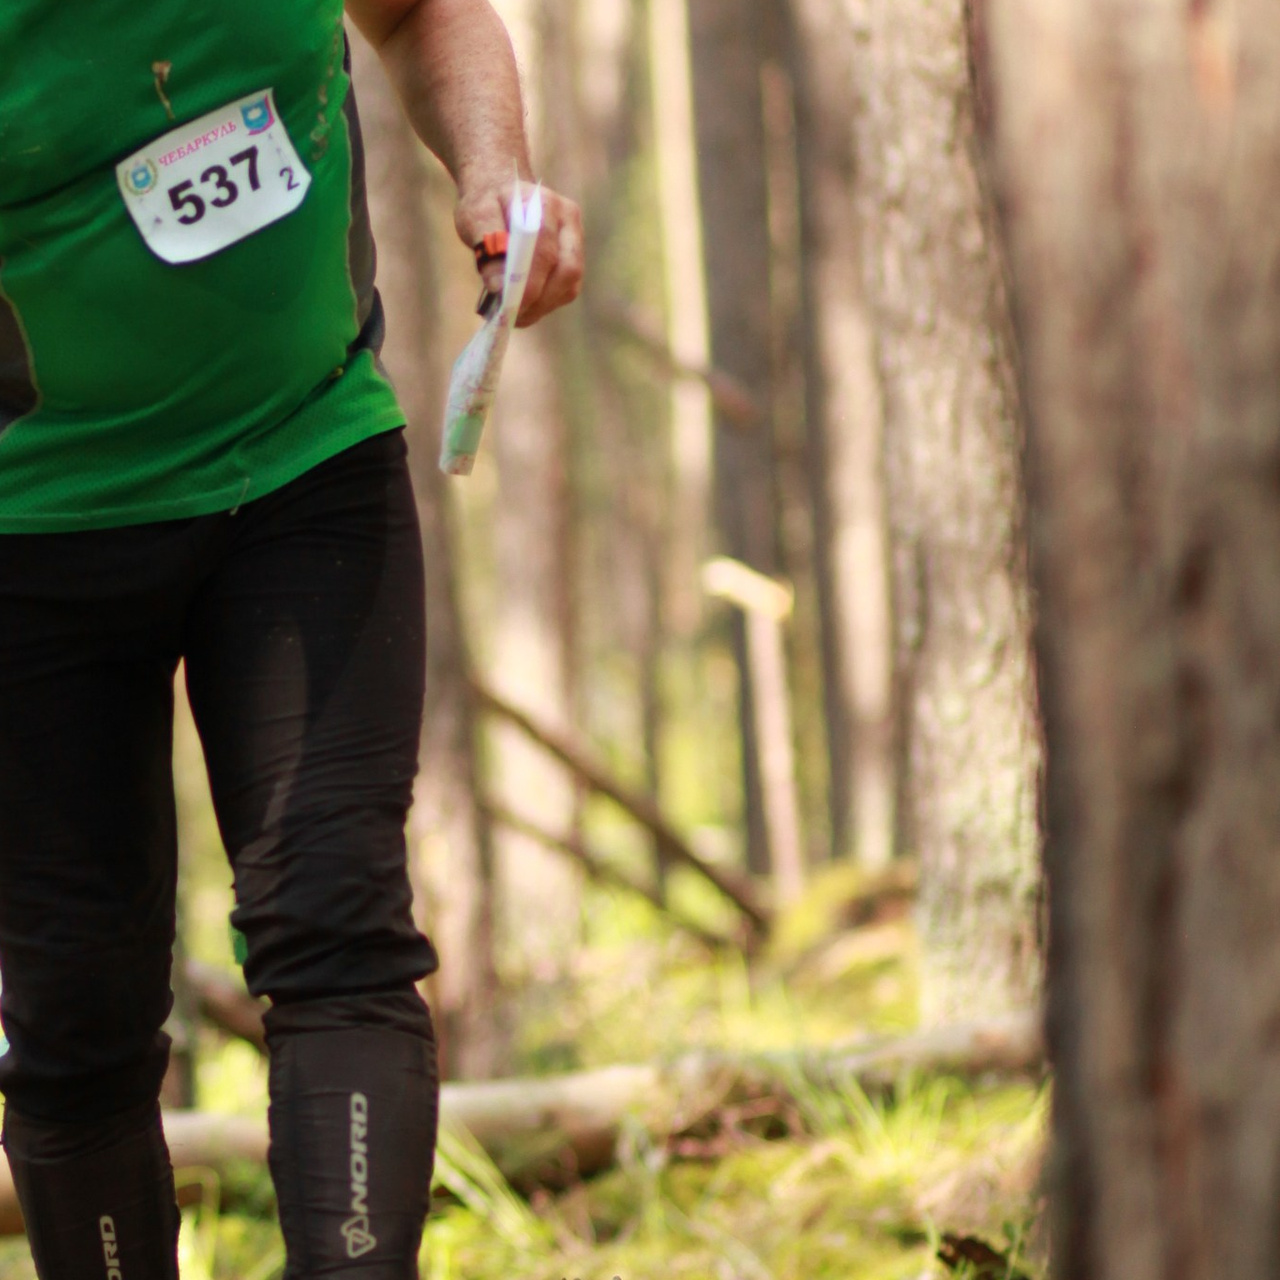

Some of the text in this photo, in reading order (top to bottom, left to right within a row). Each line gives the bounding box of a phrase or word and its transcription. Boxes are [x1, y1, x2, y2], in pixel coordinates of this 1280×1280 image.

[158, 121, 237, 166] ЧЕБАРКУЛЬ
[167, 144, 261, 225] 537
[279, 166, 300, 191] 2
[350, 1092, 368, 1214] NORD
